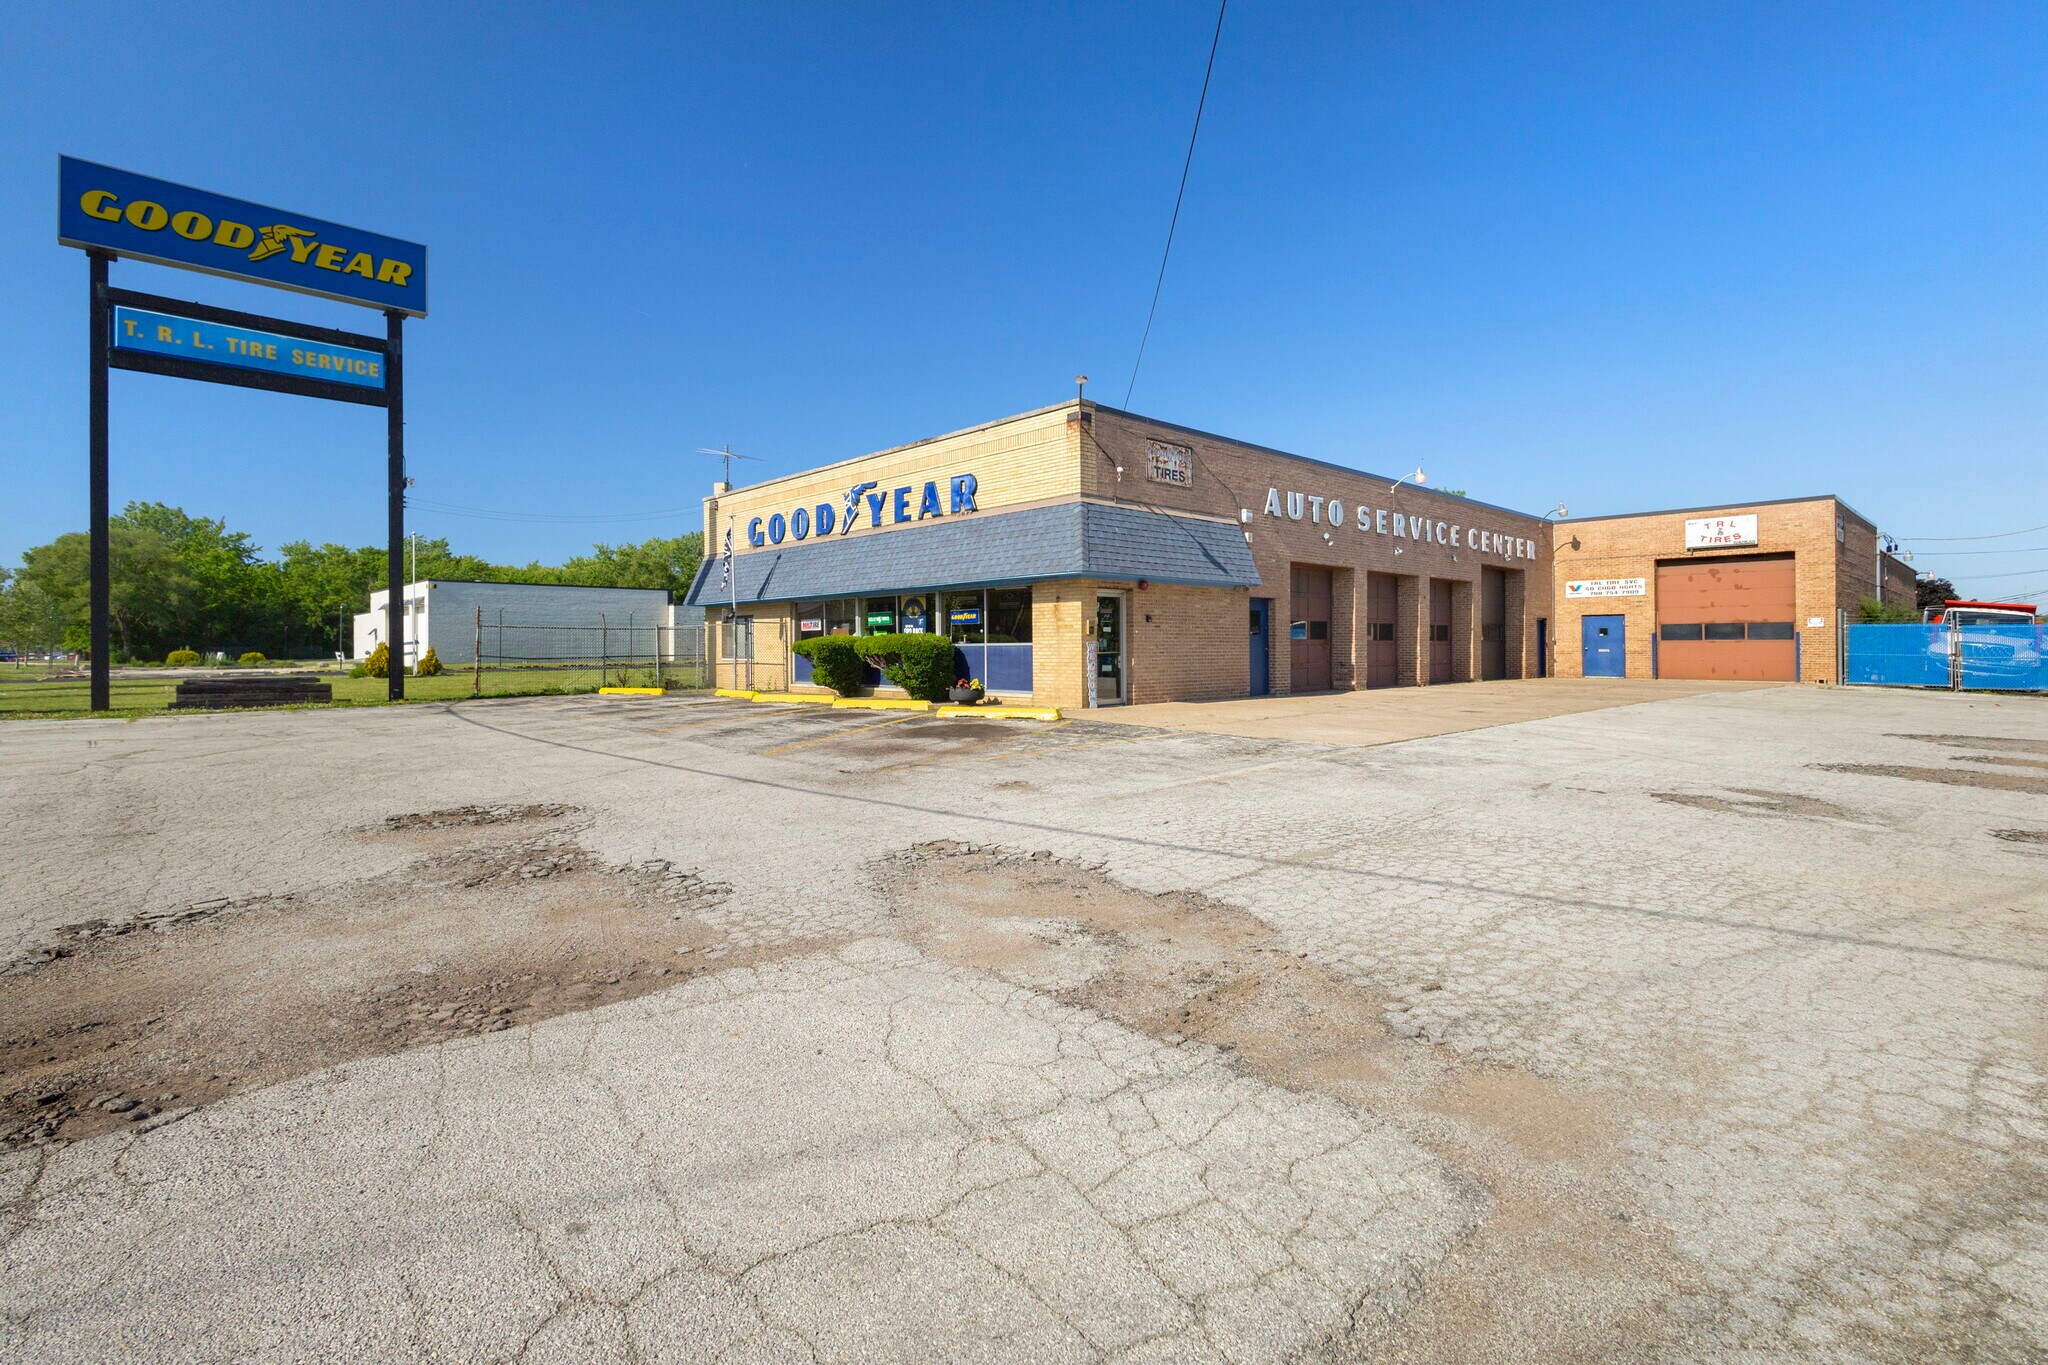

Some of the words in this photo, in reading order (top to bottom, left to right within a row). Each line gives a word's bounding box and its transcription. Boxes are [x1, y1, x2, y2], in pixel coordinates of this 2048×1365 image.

[80, 189, 413, 287] GOODYEAR
[226, 337, 277, 361] TIRE
[291, 349, 379, 377] SERVICE
[1154, 465, 1186, 483] TIRES
[748, 473, 978, 547] GOODYEAR
[1264, 487, 1344, 527] AUTO
[1357, 505, 1460, 547] SERVICE
[1468, 528, 1536, 560] CENTER
[1700, 533, 1741, 544] TIRES
